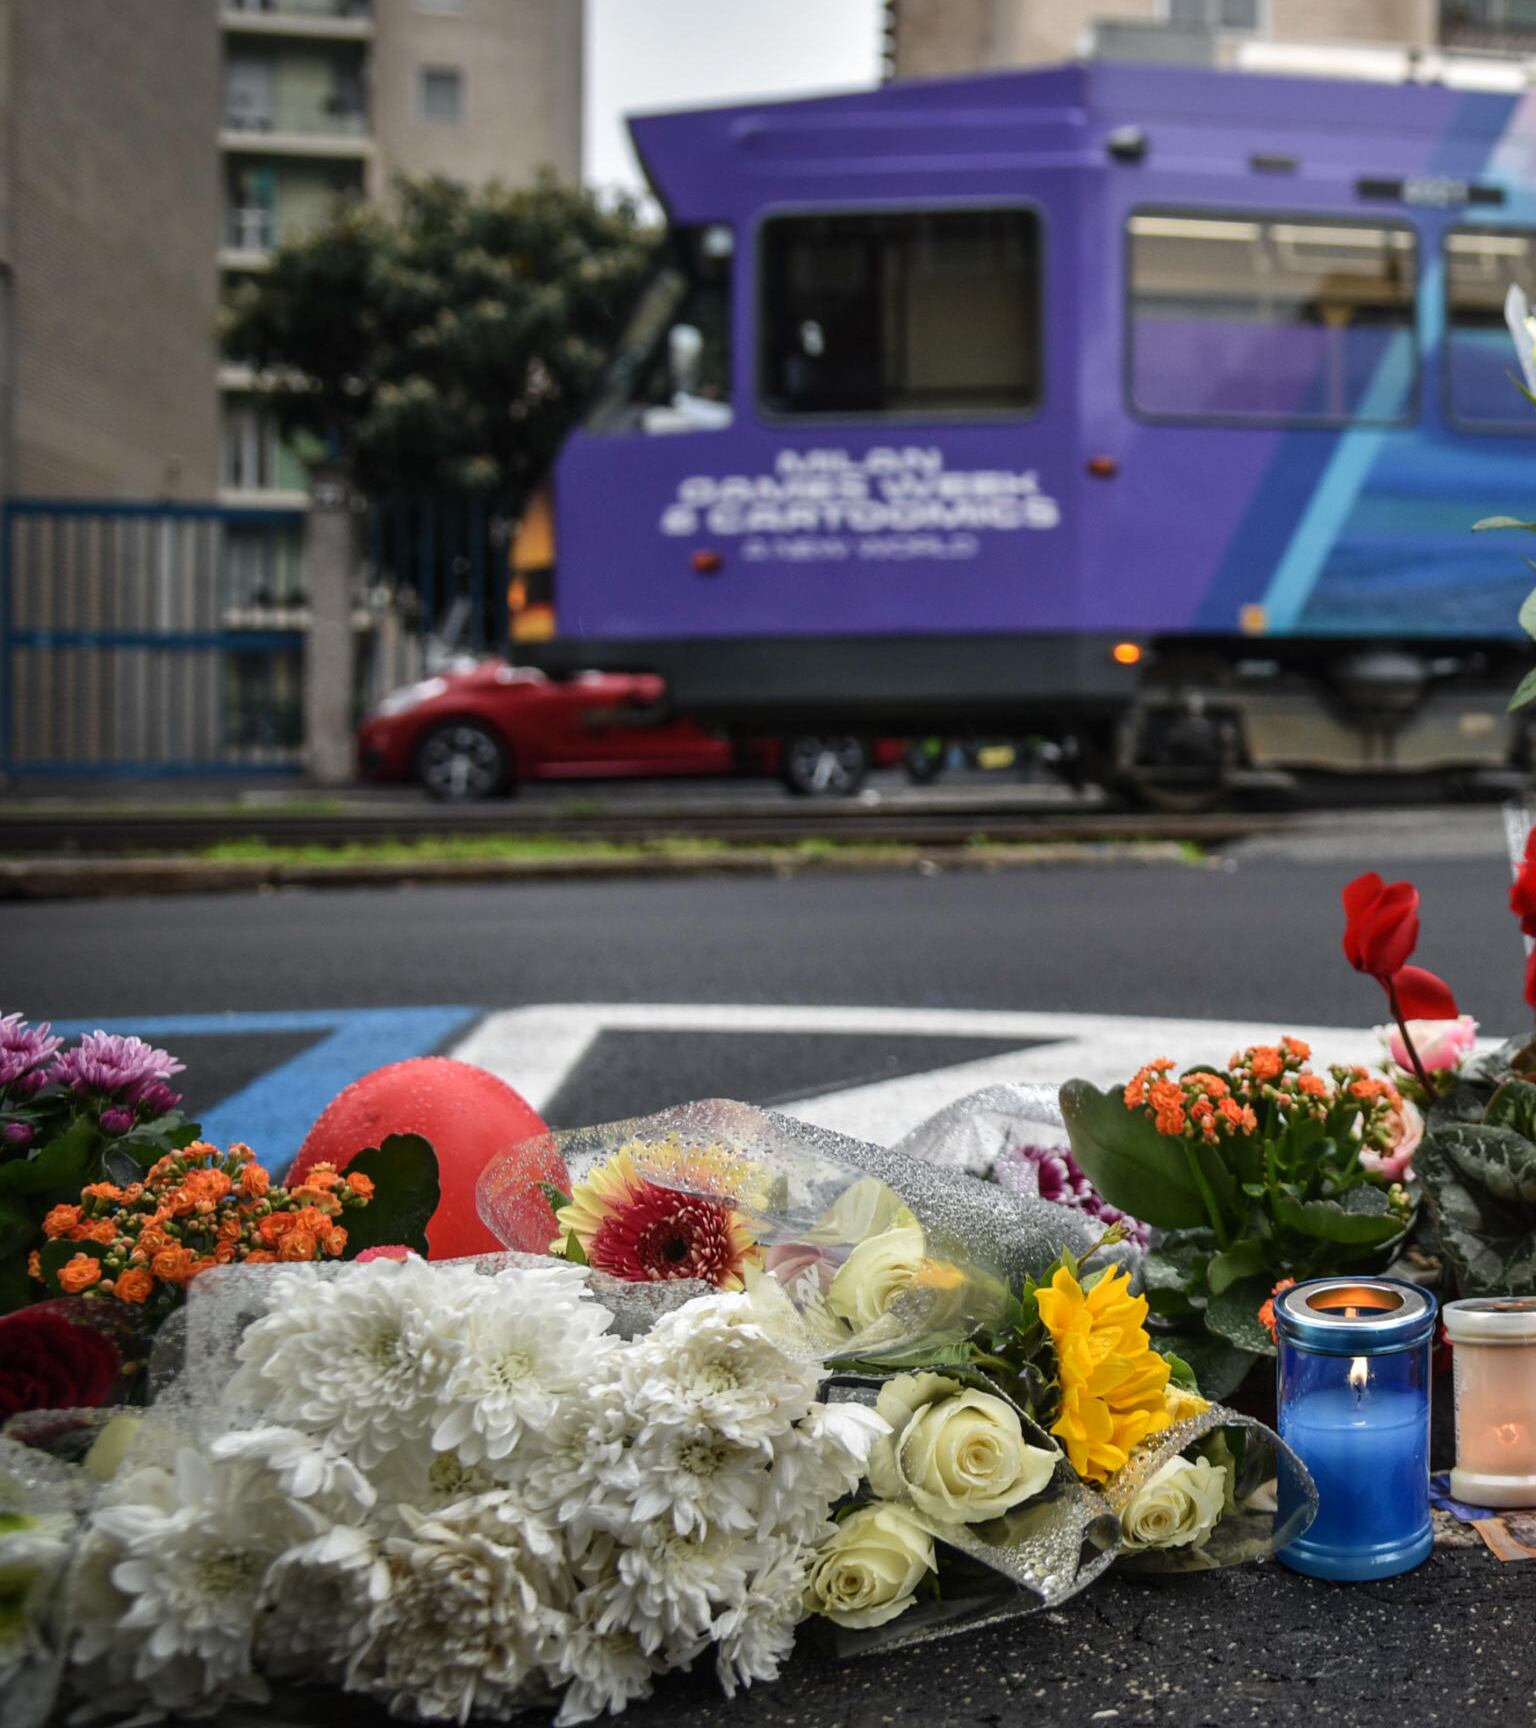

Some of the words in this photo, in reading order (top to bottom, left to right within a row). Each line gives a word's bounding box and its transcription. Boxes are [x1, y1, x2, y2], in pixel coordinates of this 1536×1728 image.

[776, 447, 942, 474] MILAN
[678, 474, 868, 504] GAMES
[879, 470, 1039, 498] WEEK
